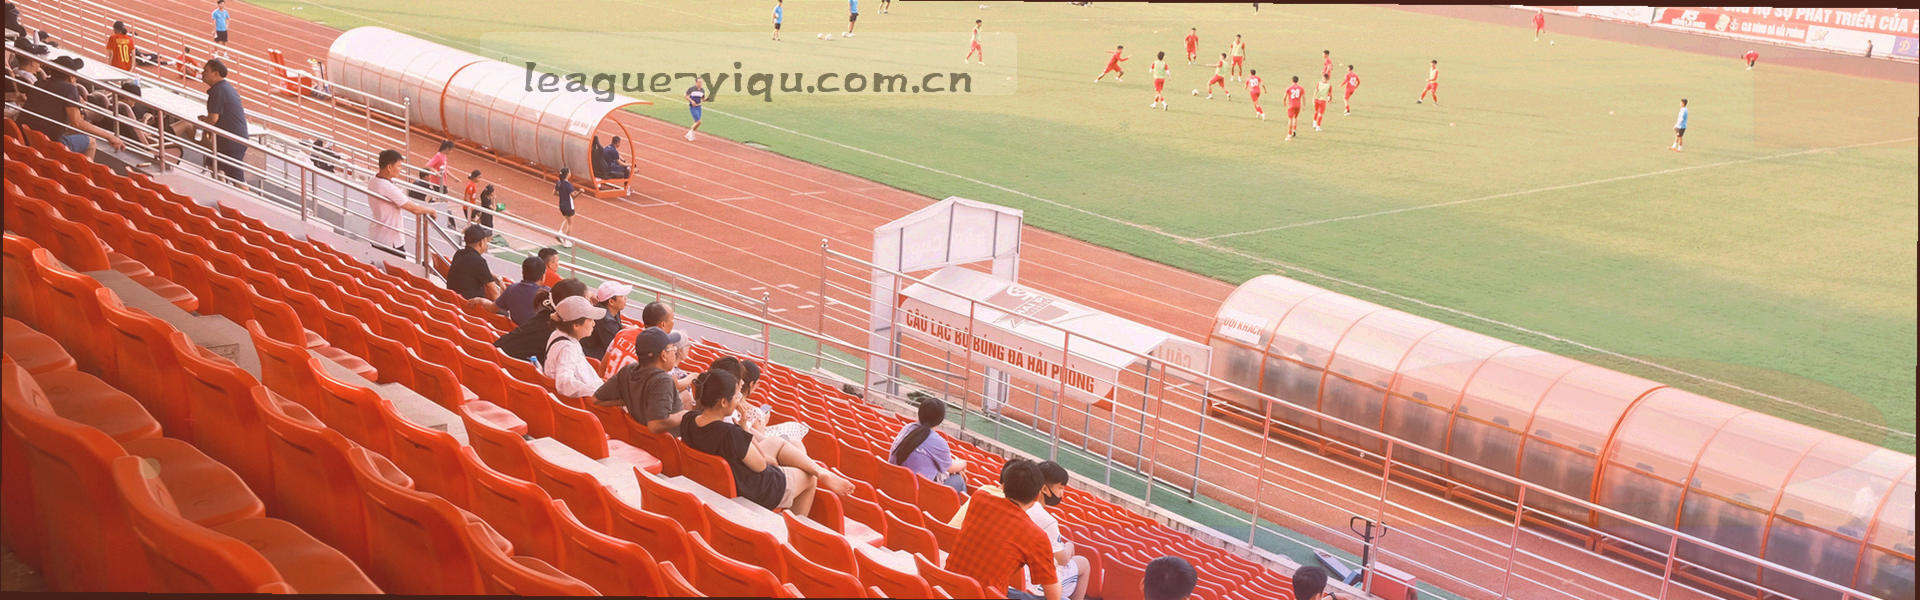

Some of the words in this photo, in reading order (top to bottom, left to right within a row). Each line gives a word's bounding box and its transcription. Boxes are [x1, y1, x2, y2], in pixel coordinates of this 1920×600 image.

[117, 44, 130, 63] 10
[973, 334, 1004, 361] BÓNG
[1008, 347, 1023, 368] ĐÁ
[1028, 352, 1047, 376] HẢI
